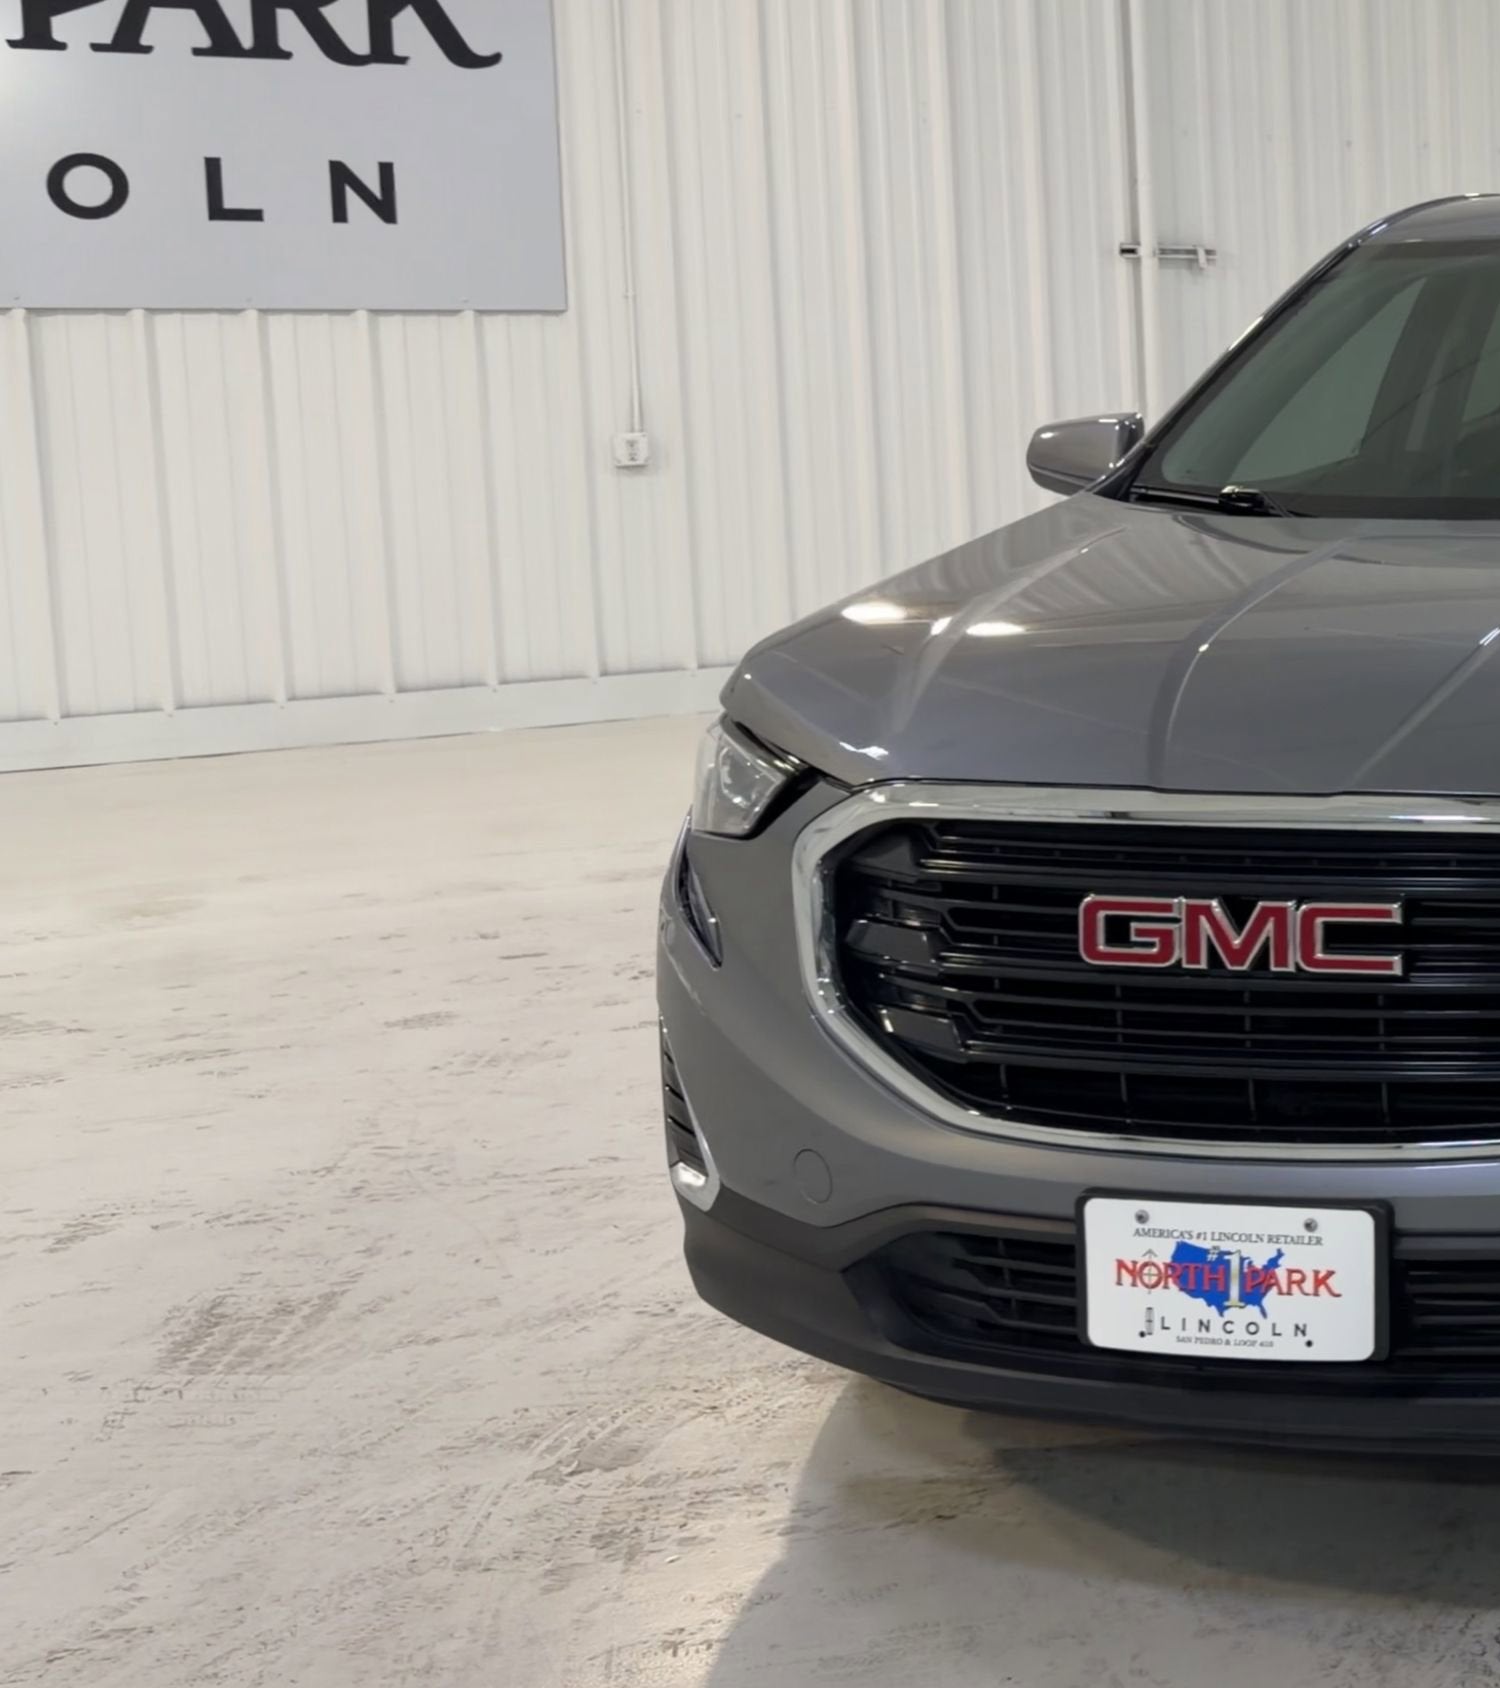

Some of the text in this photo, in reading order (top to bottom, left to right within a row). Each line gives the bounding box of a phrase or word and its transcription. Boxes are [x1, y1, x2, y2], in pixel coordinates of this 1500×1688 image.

[1079, 895, 1402, 976] GMC
[1133, 1227, 1194, 1240] AMERICA'S
[1210, 1231, 1265, 1243] LINCOLN
[1267, 1234, 1323, 1246] RETAILER
[1115, 1259, 1342, 1298] NORTH PARK
[1160, 1316, 1308, 1337] LINCOLN
